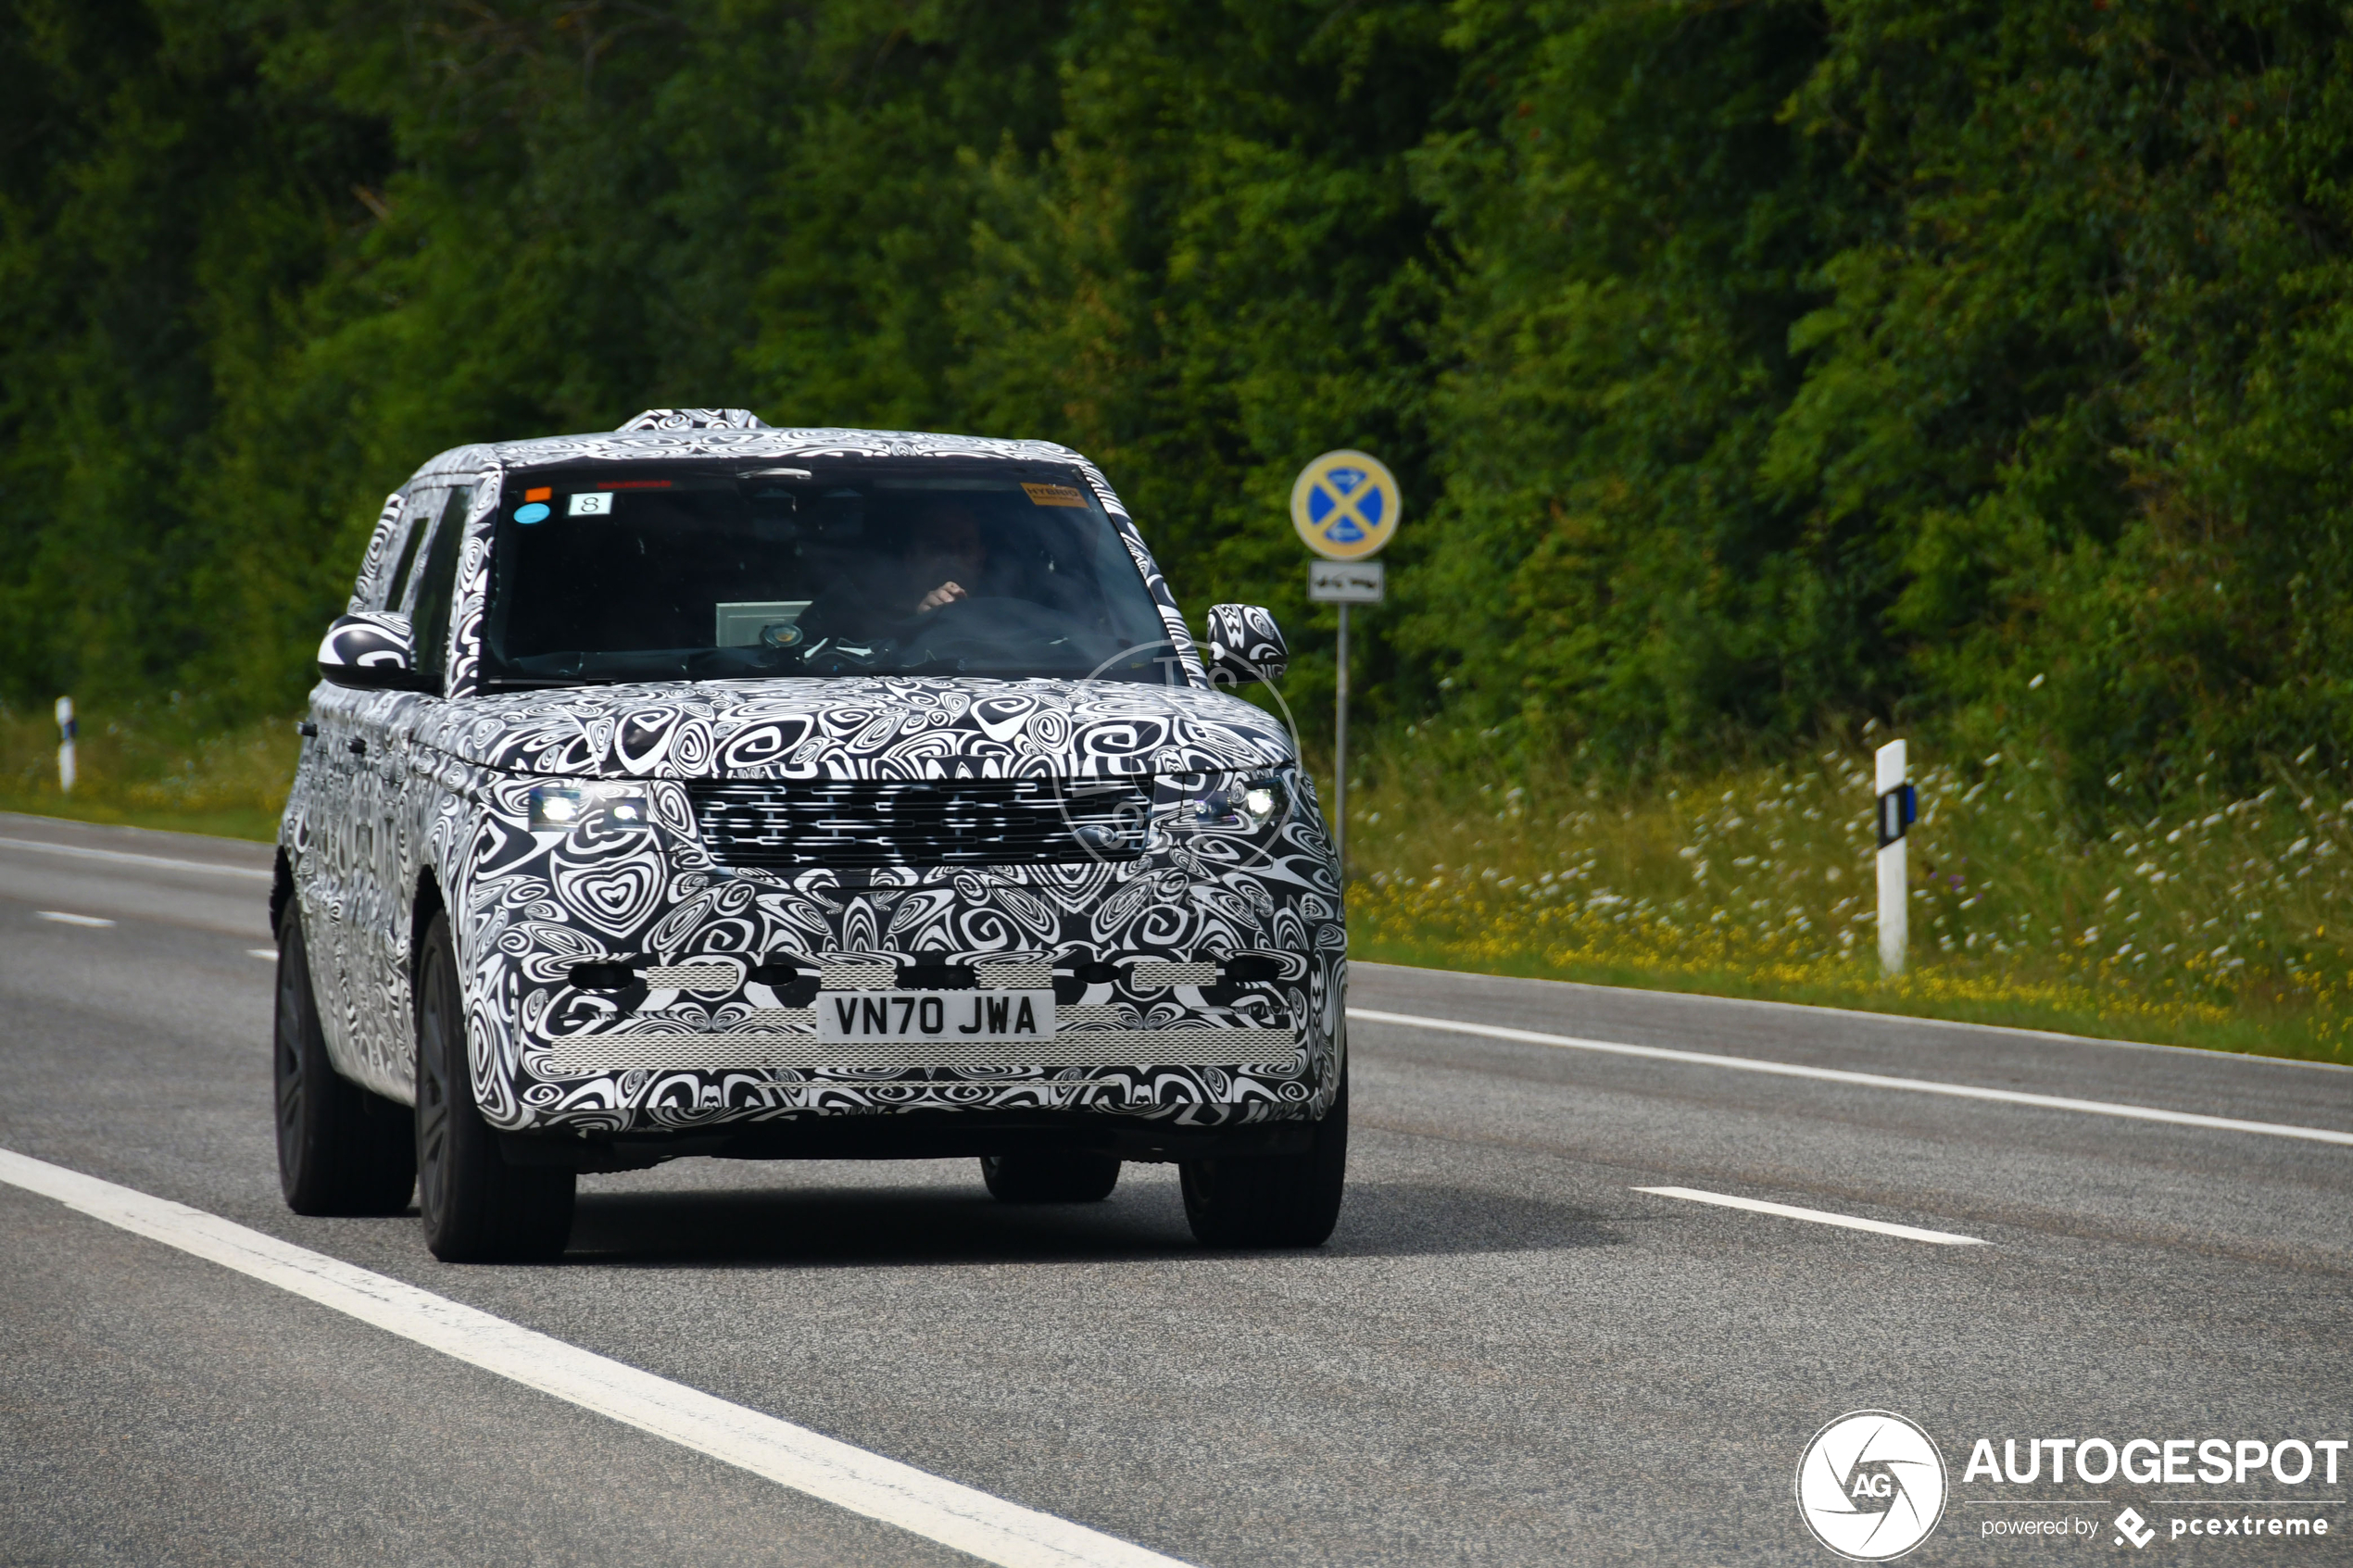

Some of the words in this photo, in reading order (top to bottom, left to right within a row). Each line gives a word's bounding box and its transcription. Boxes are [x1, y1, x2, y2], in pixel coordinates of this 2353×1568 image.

[1026, 487, 1078, 496] HYBRID
[582, 497, 598, 512] 8
[835, 996, 944, 1035] VN70
[958, 996, 1037, 1035] JWA
